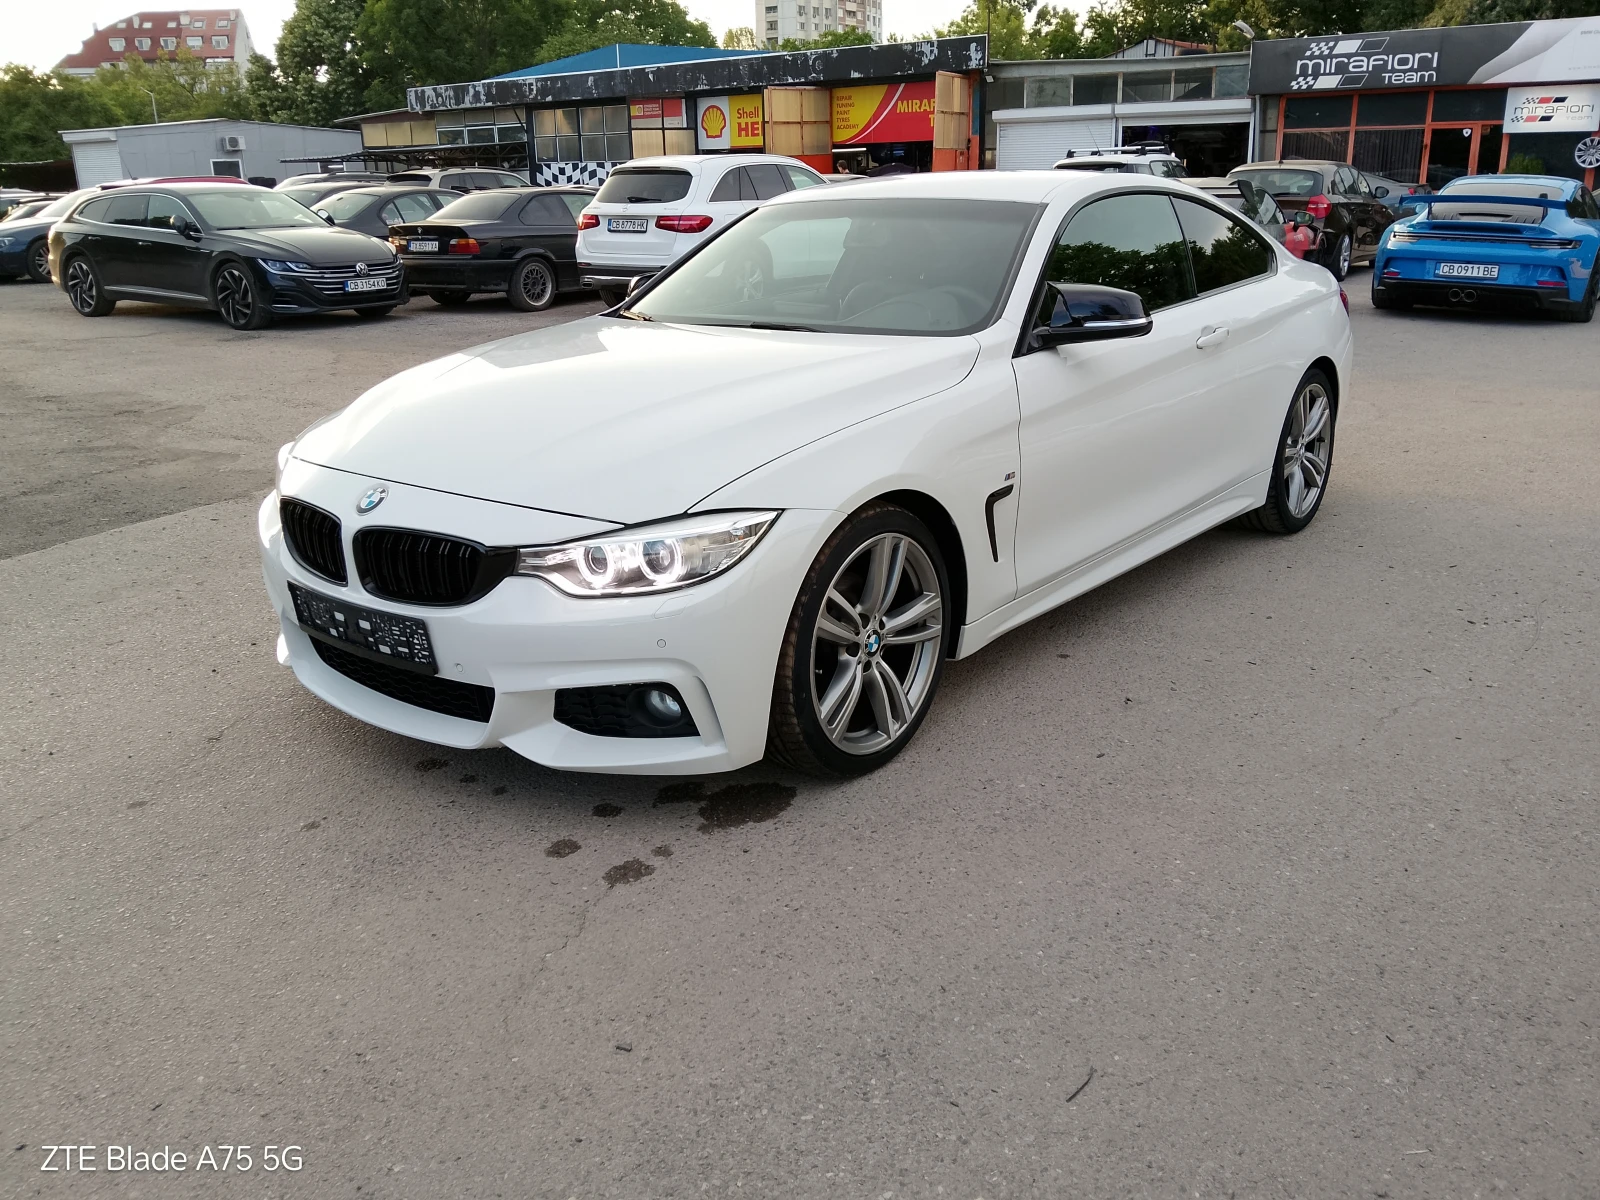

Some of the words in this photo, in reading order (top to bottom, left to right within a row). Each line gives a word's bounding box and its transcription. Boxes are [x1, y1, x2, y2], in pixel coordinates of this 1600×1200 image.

[1295, 51, 1438, 75] mirafiori
[1382, 70, 1436, 84] Team
[736, 105, 760, 119] Shell
[1513, 104, 1595, 115] mirafiori
[611, 220, 620, 229] CB
[621, 220, 636, 230] 8778
[1441, 264, 1455, 275] CB
[1456, 265, 1481, 276] 0911
[1482, 266, 1498, 277] BE
